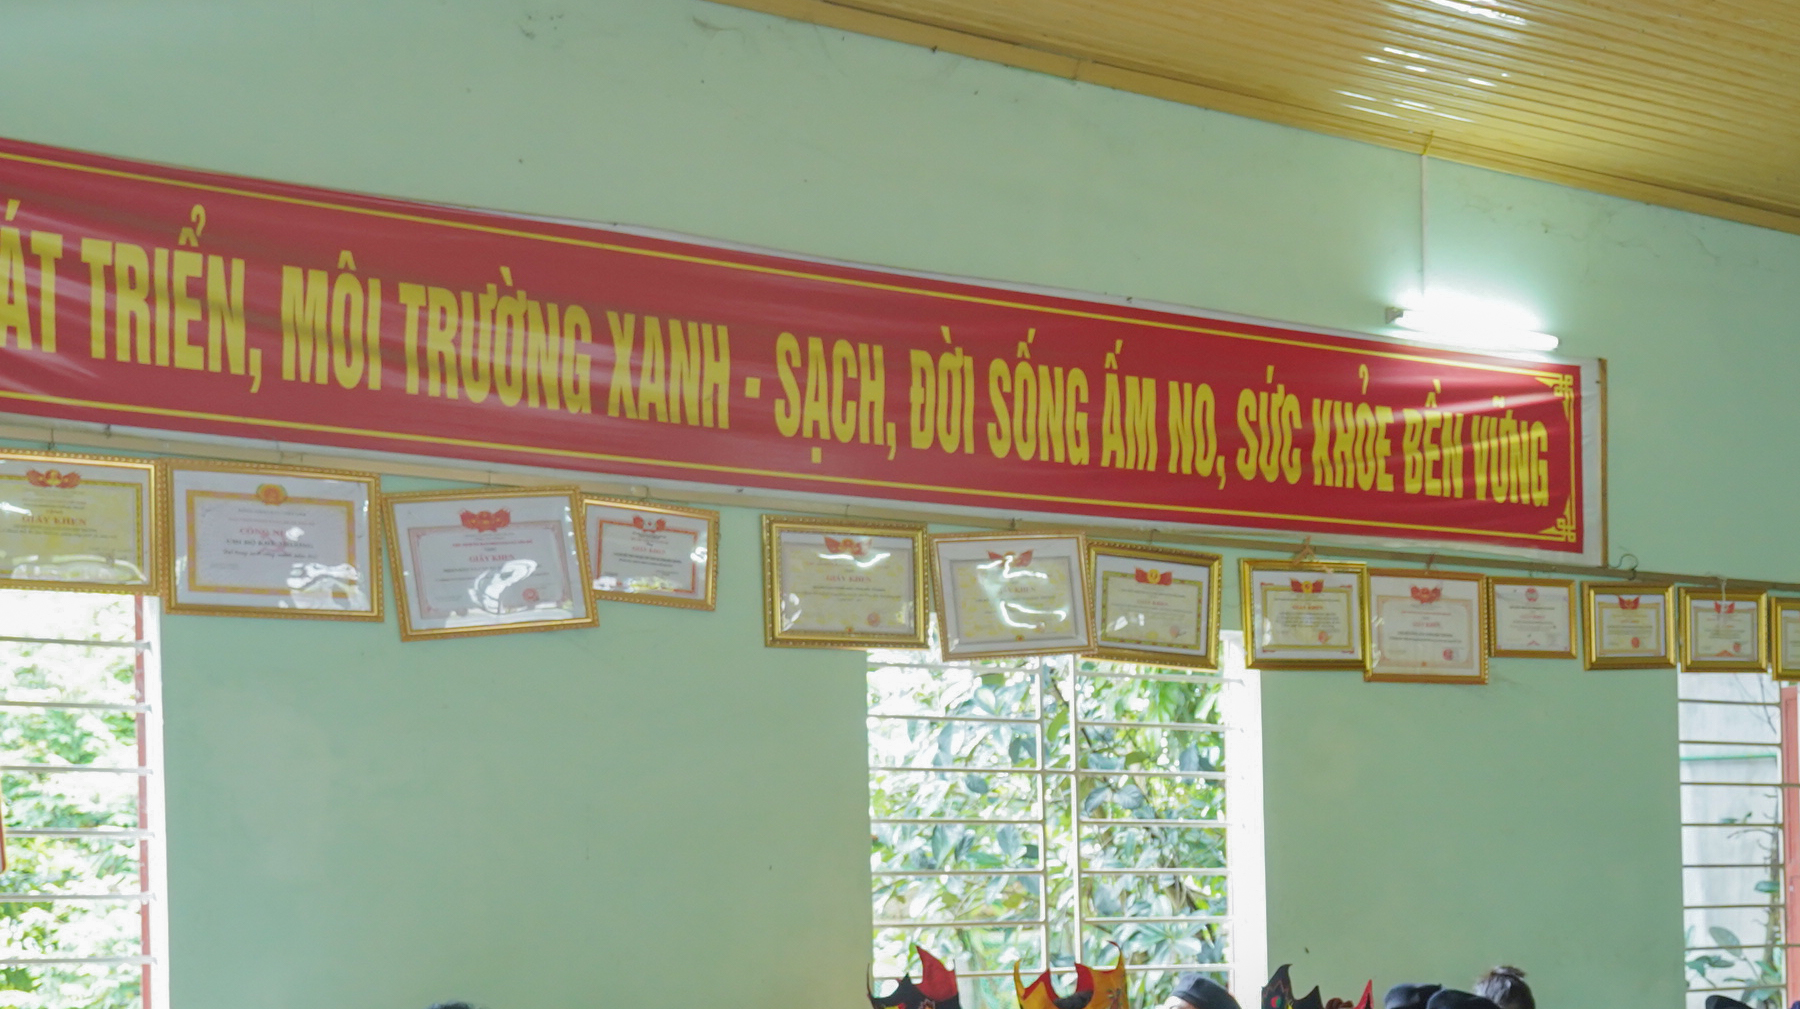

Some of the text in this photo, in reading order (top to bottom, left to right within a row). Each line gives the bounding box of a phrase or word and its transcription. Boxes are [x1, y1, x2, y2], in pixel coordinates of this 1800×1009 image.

[81, 205, 262, 394] TRIỂN,
[281, 251, 382, 391] MÔI
[400, 266, 592, 415] TRƯỜNG
[607, 311, 731, 430] XANH
[745, 377, 761, 399] -
[775, 333, 897, 465] SẠCH,
[910, 326, 976, 455] ĐỜI
[988, 329, 1091, 466] SỐNG
[1101, 340, 1158, 472] ẤM
[1169, 381, 1227, 490] NO,
[1236, 365, 1302, 485] SỨC
[1312, 364, 1395, 493] KHỎE
[1402, 379, 1464, 498] BỀN
[1471, 396, 1550, 508] VỮNG
